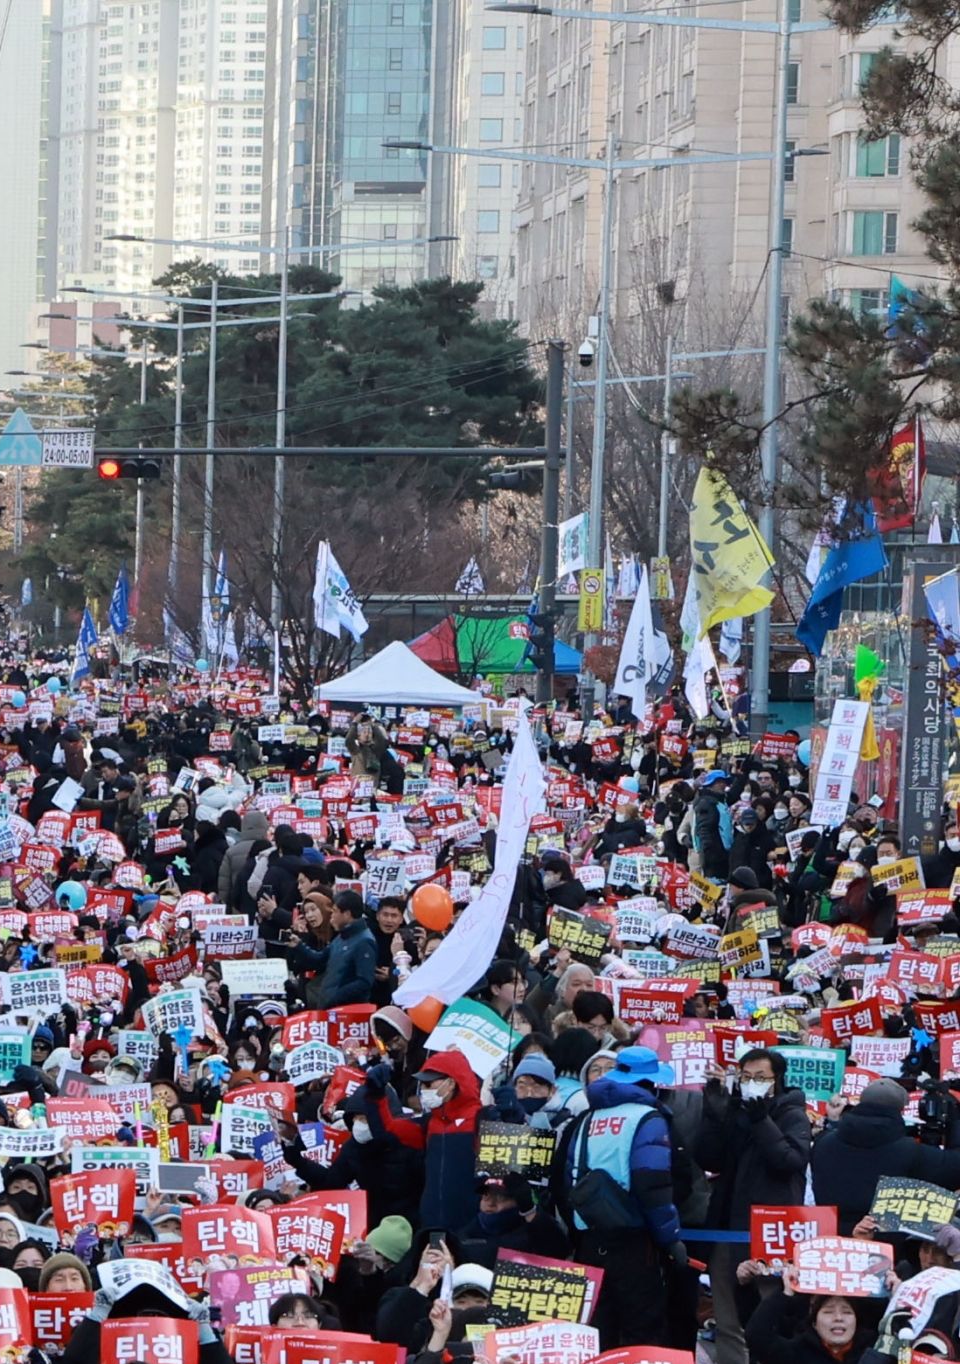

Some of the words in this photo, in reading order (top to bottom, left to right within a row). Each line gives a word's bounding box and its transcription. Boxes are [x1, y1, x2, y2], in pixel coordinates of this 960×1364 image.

[44, 450, 90, 465] 24:00-05:00
[435, 805, 458, 821] 탄핵
[209, 930, 254, 945] 내란수괴
[673, 928, 720, 949] 내란수괴
[897, 958, 940, 985] 탄핵
[9, 978, 61, 997] 윤석열을
[288, 1021, 330, 1045] 탄핵
[831, 1010, 874, 1041] 탄핵
[919, 1012, 960, 1037] 탄핵
[789, 1056, 837, 1076] 민의힘
[478, 1148, 514, 1165] 즉각
[516, 1148, 553, 1167] 탄핵!
[62, 1182, 120, 1223] 탄핵
[197, 1216, 260, 1254] 탄핵
[276, 1215, 336, 1241] 윤석열을
[275, 1234, 333, 1260] 탄핵하라
[495, 1274, 542, 1291] 내란수괴
[798, 1271, 837, 1291] 탄핵
[841, 1271, 882, 1292] 구속
